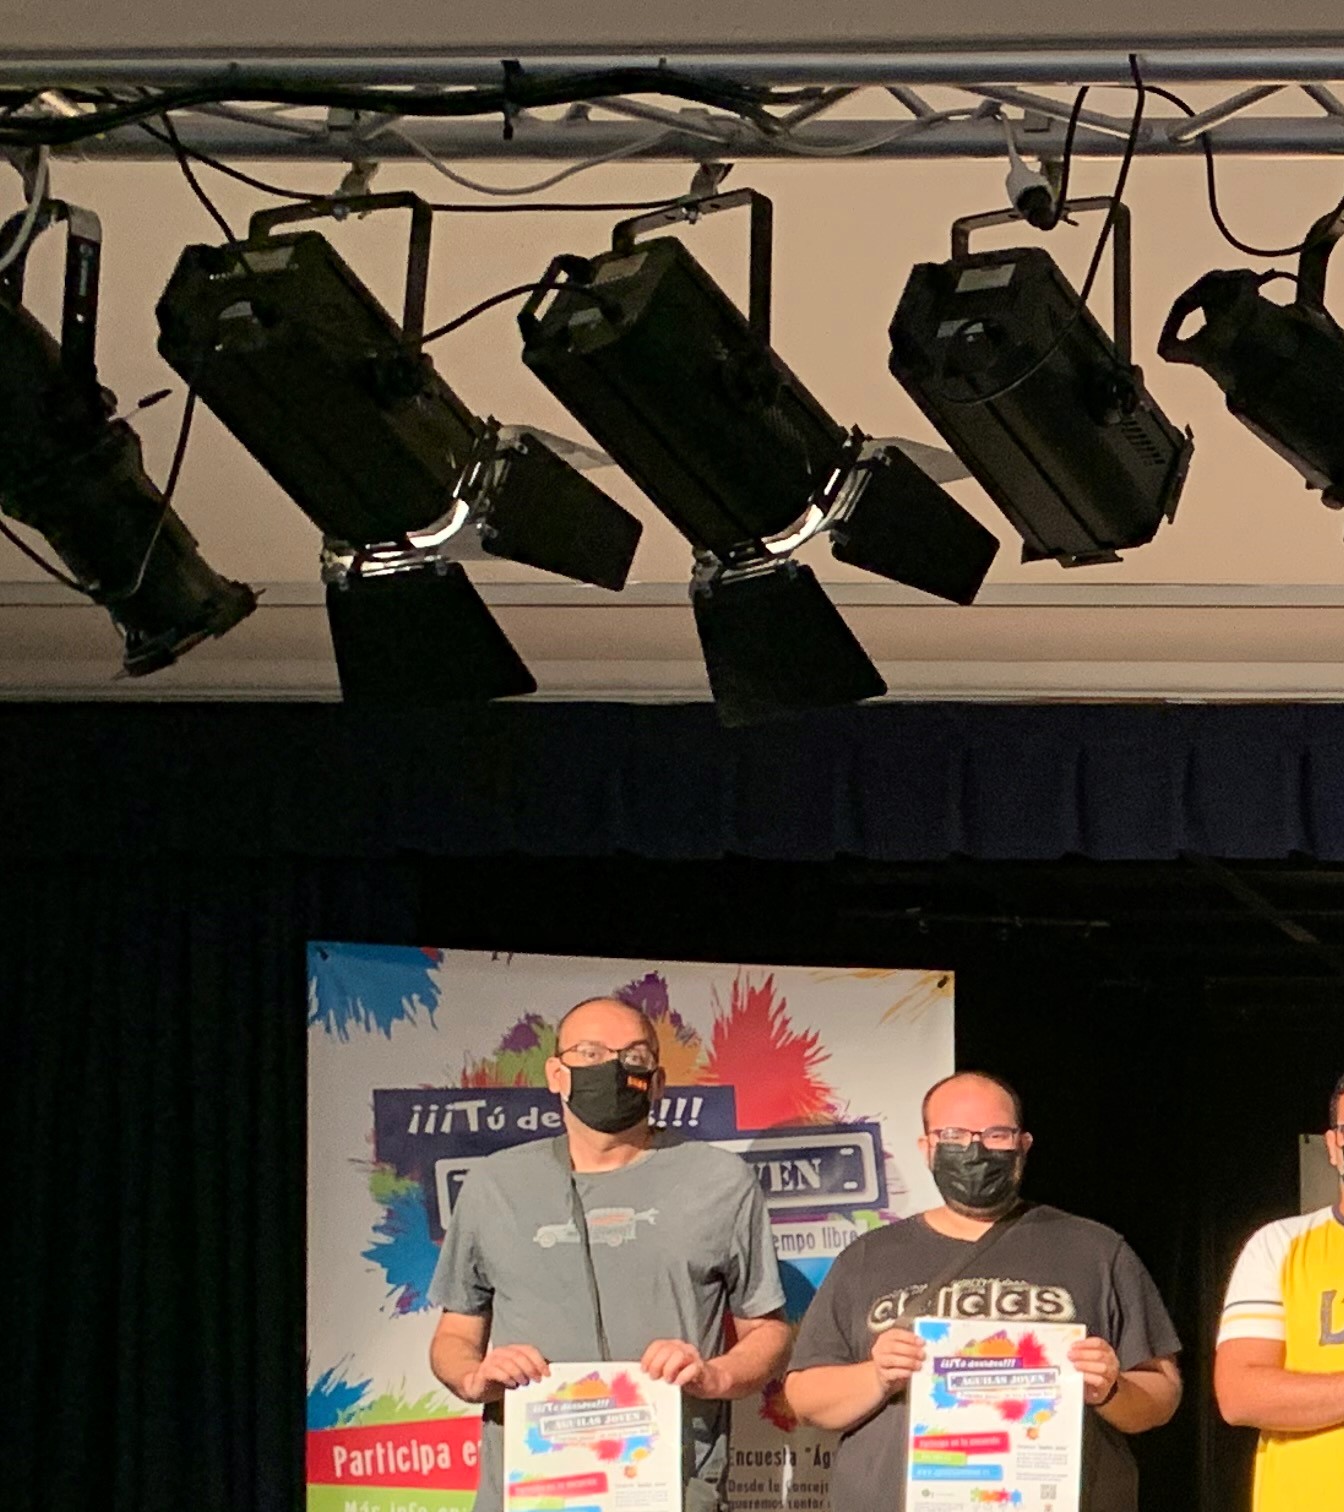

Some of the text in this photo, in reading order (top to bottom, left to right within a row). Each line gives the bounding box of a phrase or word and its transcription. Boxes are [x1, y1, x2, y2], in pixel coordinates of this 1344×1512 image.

[407, 1100, 505, 1135] ¡¡¡Tú
[750, 1158, 822, 1192] VEN
[773, 1232, 816, 1254] empo
[332, 1439, 482, 1478] Participa e
[805, 1444, 831, 1469] "Ág
[728, 1479, 764, 1493] Desde
[769, 1479, 780, 1493] la
